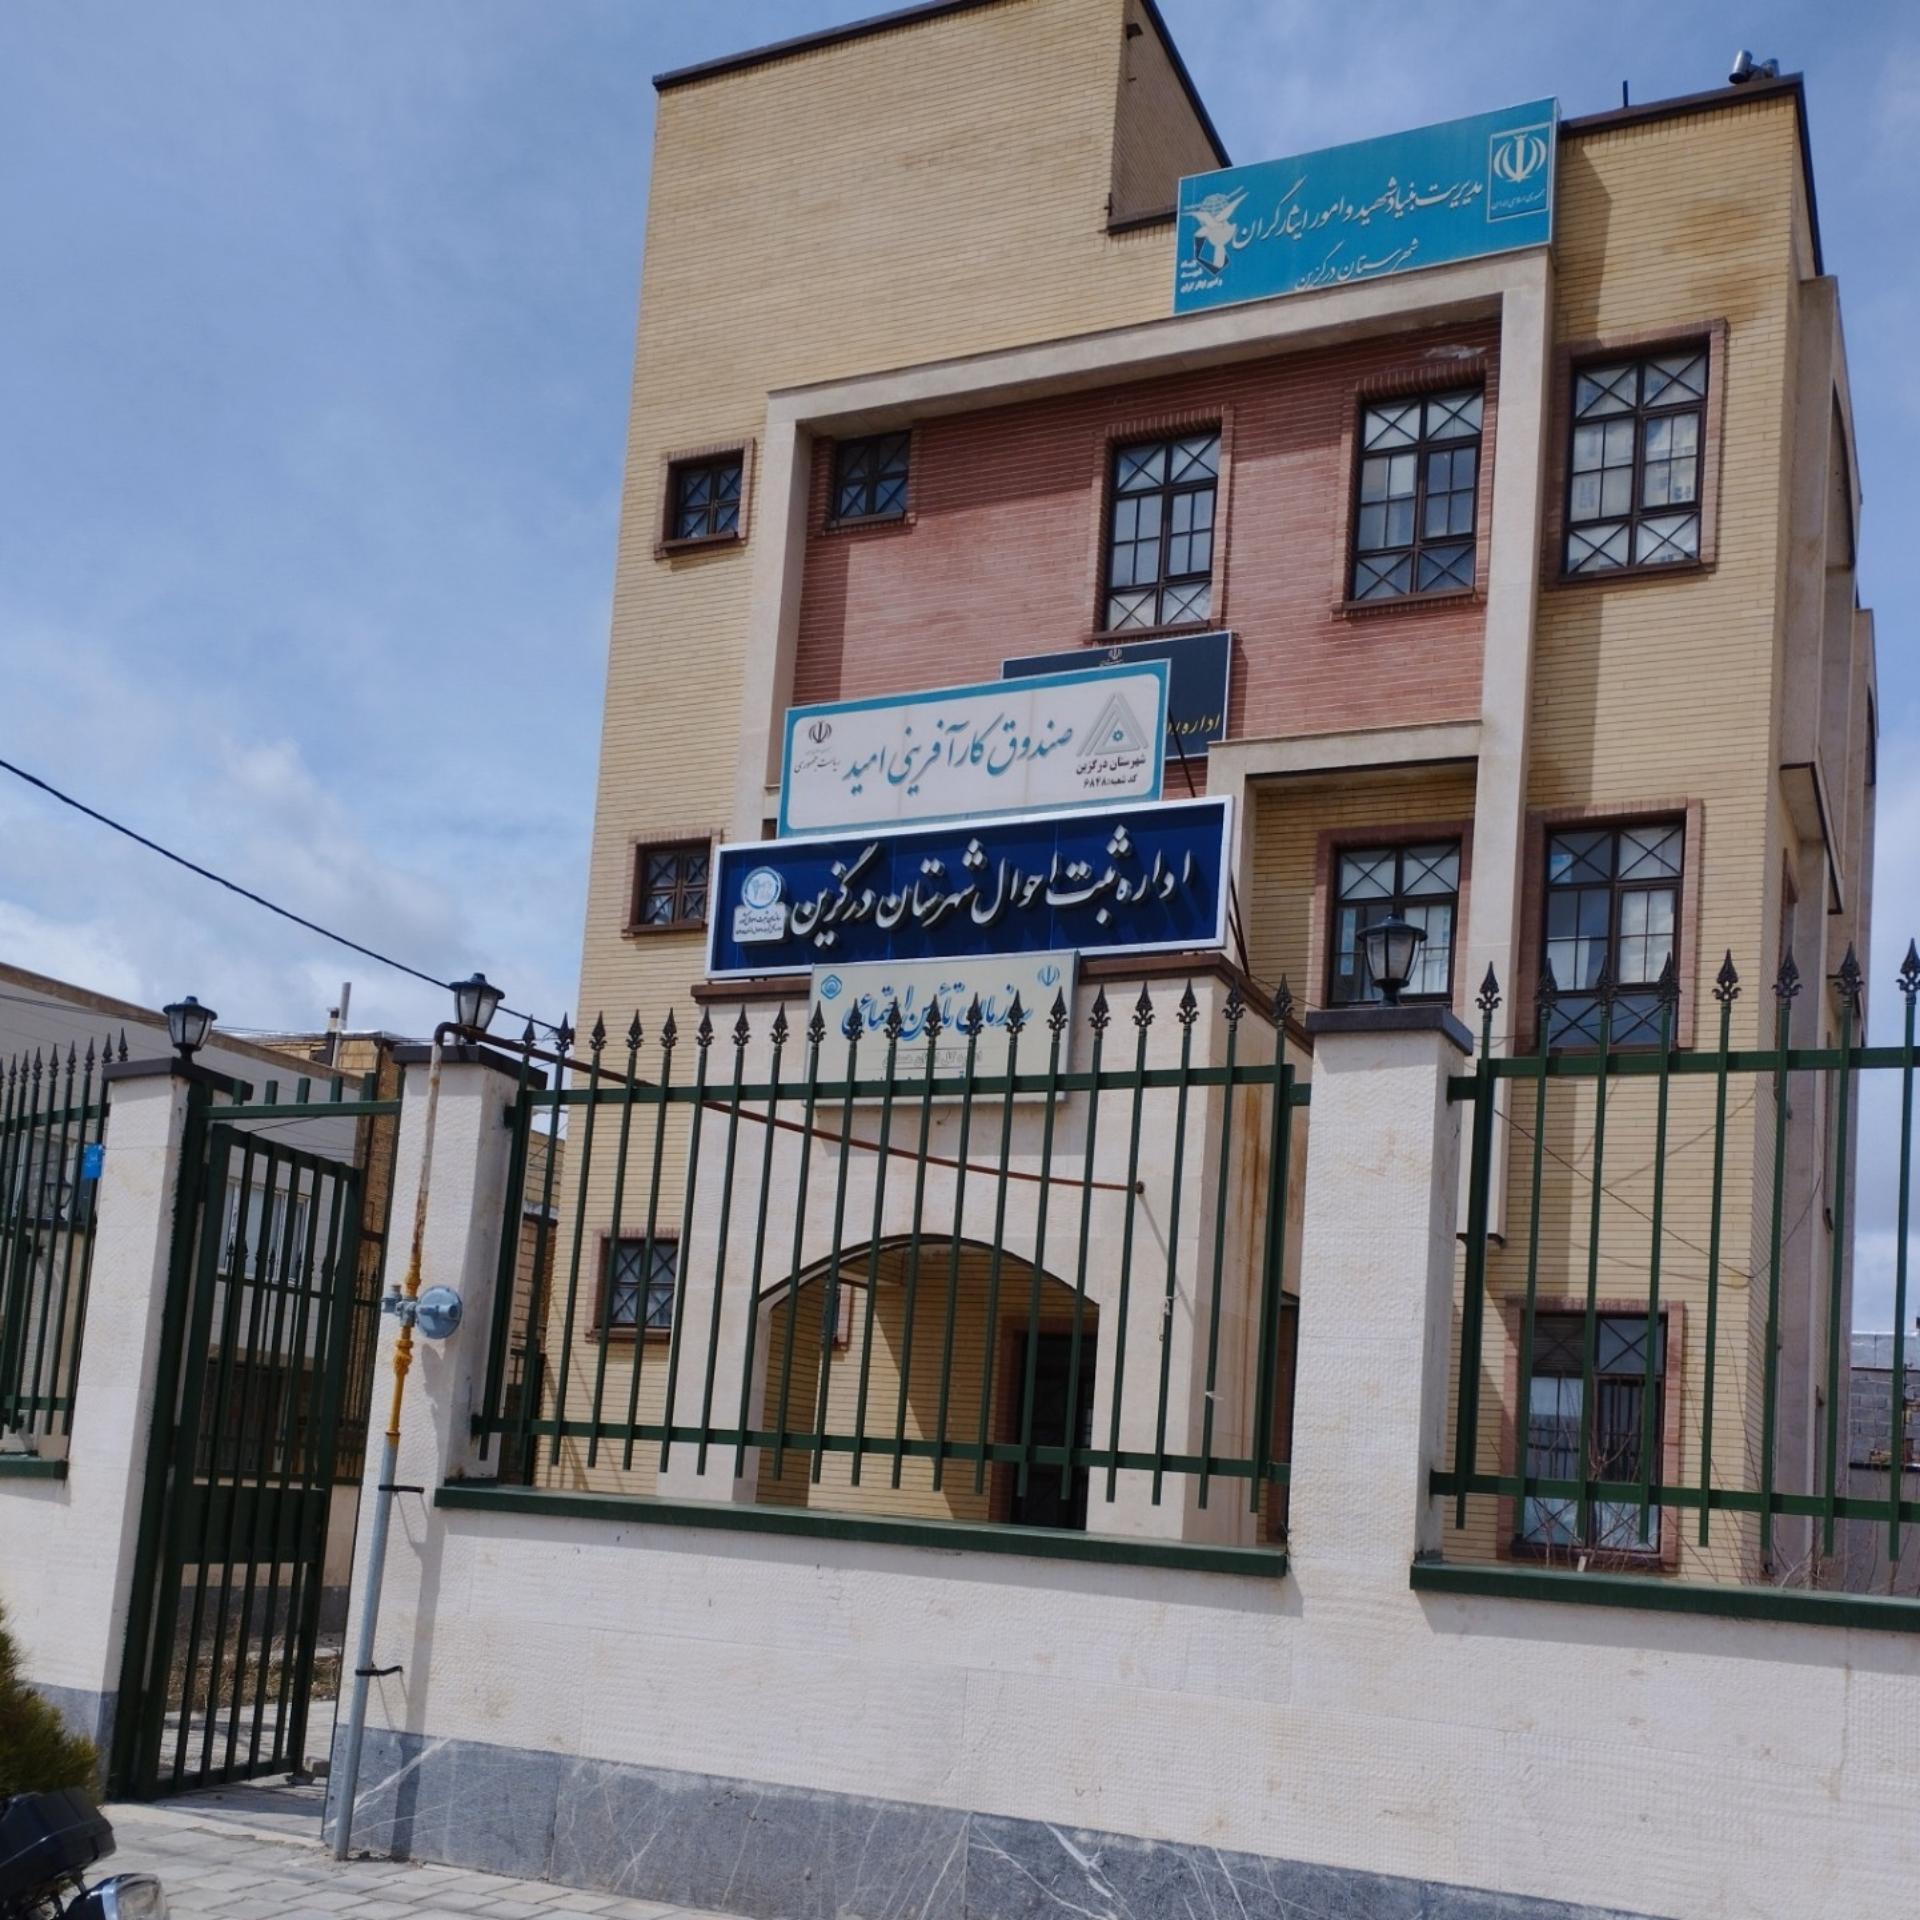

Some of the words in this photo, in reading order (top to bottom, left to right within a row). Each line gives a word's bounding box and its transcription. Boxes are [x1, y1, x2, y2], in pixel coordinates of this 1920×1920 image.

[1307, 194, 1344, 230] امور
[1342, 204, 1353, 222] و
[1415, 180, 1483, 209] مدیریت
[1336, 238, 1418, 281] شهرستان
[841, 744, 886, 797] امید
[986, 719, 1073, 777] صندوق
[1110, 754, 1147, 771] شهرستان
[790, 841, 879, 948] درگزین
[875, 837, 984, 929] شهرستان
[971, 849, 1058, 925] احوال
[1045, 824, 1130, 925] ثبت
[1116, 848, 1191, 902] اداره
[955, 983, 1034, 1036] سزمان
